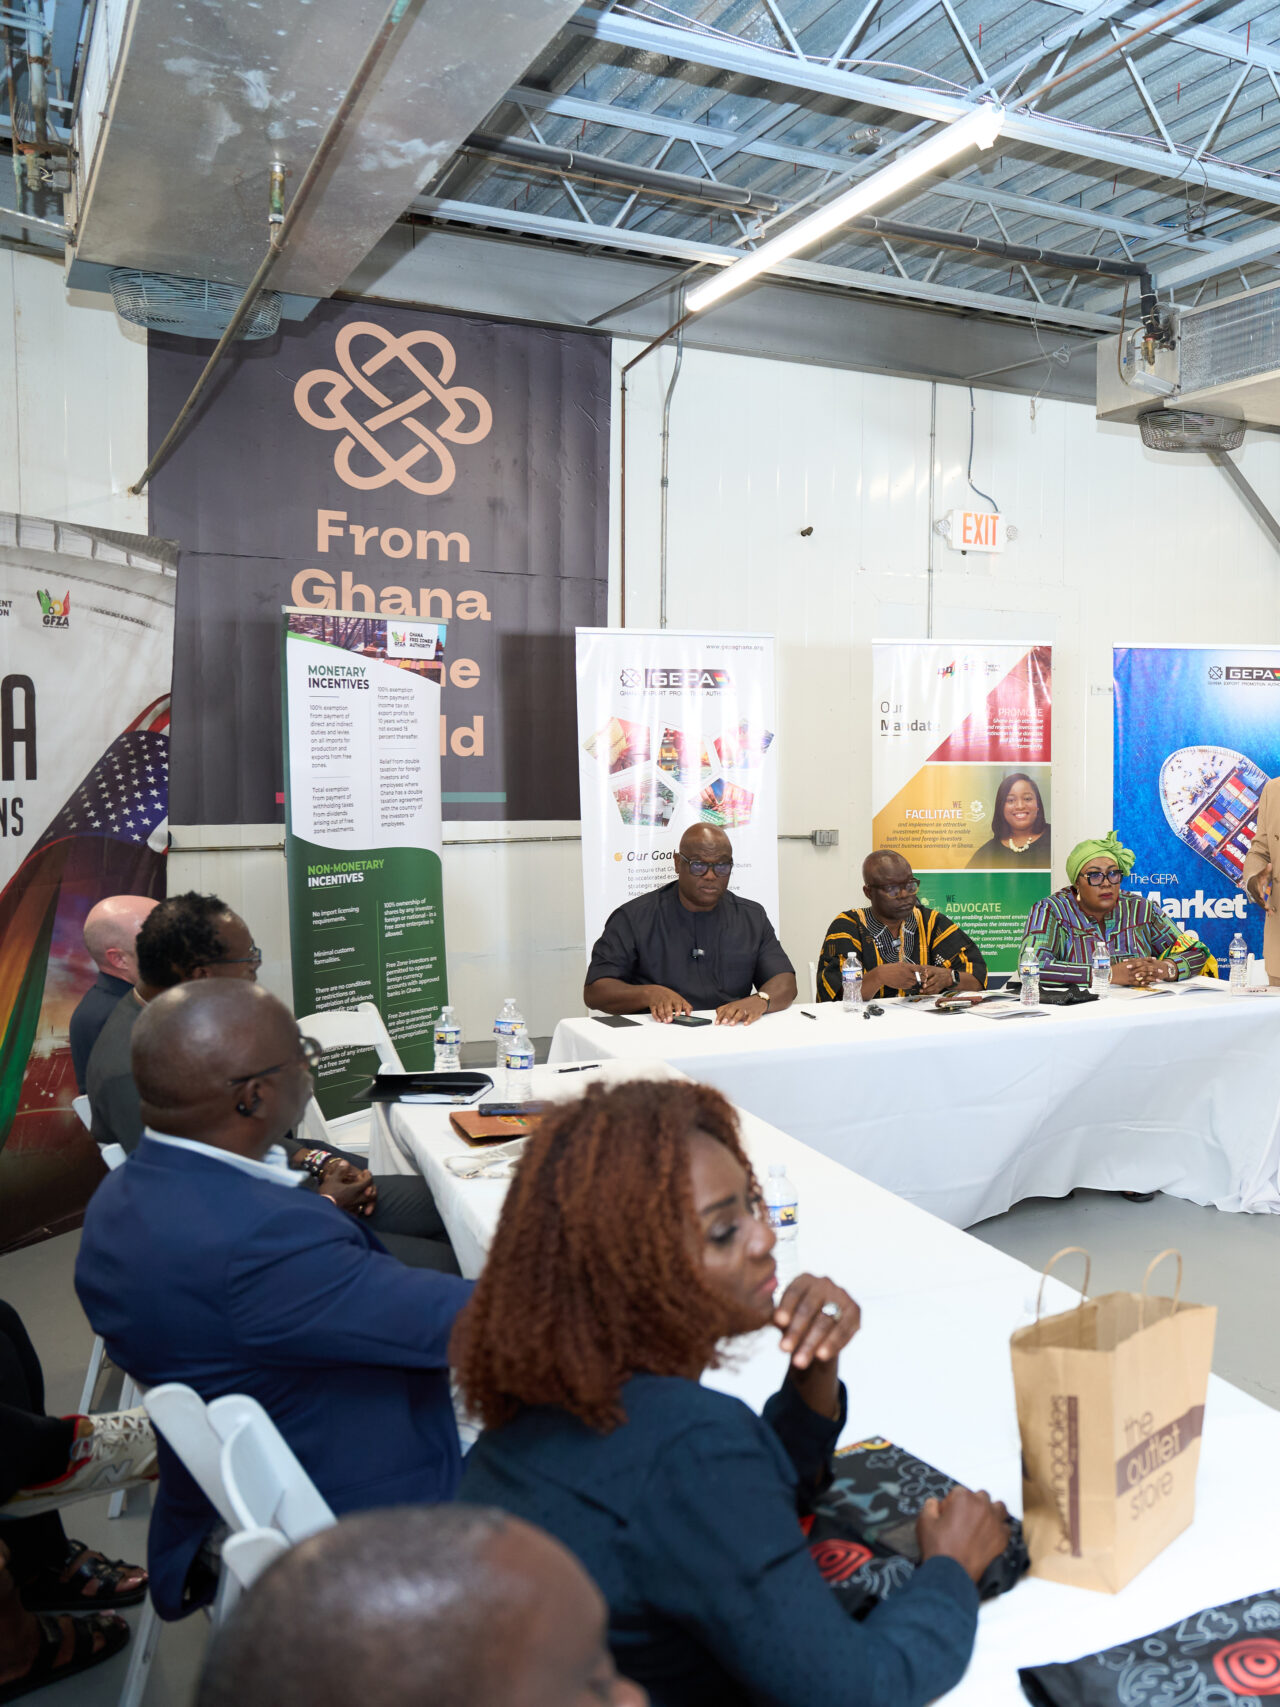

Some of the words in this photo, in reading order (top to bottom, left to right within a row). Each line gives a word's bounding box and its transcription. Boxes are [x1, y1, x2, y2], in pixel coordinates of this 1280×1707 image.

[962, 512, 1000, 546] EXIT
[317, 509, 470, 563] From
[291, 568, 491, 622] Ghana
[42, 615, 69, 627] GFZA
[308, 665, 366, 677] MONETARY
[1229, 668, 1274, 680] GEPA
[308, 678, 370, 690] INCENTIVES
[651, 672, 715, 687] GEPA
[952, 801, 962, 809] WE
[905, 809, 963, 819] FACILITATE
[627, 851, 648, 861] Our
[308, 859, 384, 876] NON-MONETARY
[308, 872, 364, 887] INCENTIVES
[1130, 873, 1149, 884] The
[1150, 873, 1179, 884] GEPA
[396, 899, 420, 907] ownership
[946, 894, 956, 902] WE
[321, 909, 337, 917] import
[338, 906, 360, 914] licensing
[945, 902, 1001, 912] ADVOCATE
[314, 949, 334, 958] Minimal
[334, 947, 355, 955] customs
[386, 967, 409, 976] permitted
[386, 975, 402, 983] foreign
[403, 972, 423, 980] currency
[387, 981, 407, 990] accounts
[419, 976, 440, 984] approved
[345, 979, 372, 989] conditions
[322, 991, 348, 1001] restrictions
[387, 990, 401, 998] banks
[316, 999, 344, 1009] repatriation
[350, 993, 374, 1003] dividends
[327, 1060, 337, 1068] free
[1124, 1410, 1154, 1445] the
[1126, 1425, 1181, 1485] outlet
[1130, 1471, 1174, 1520] store
